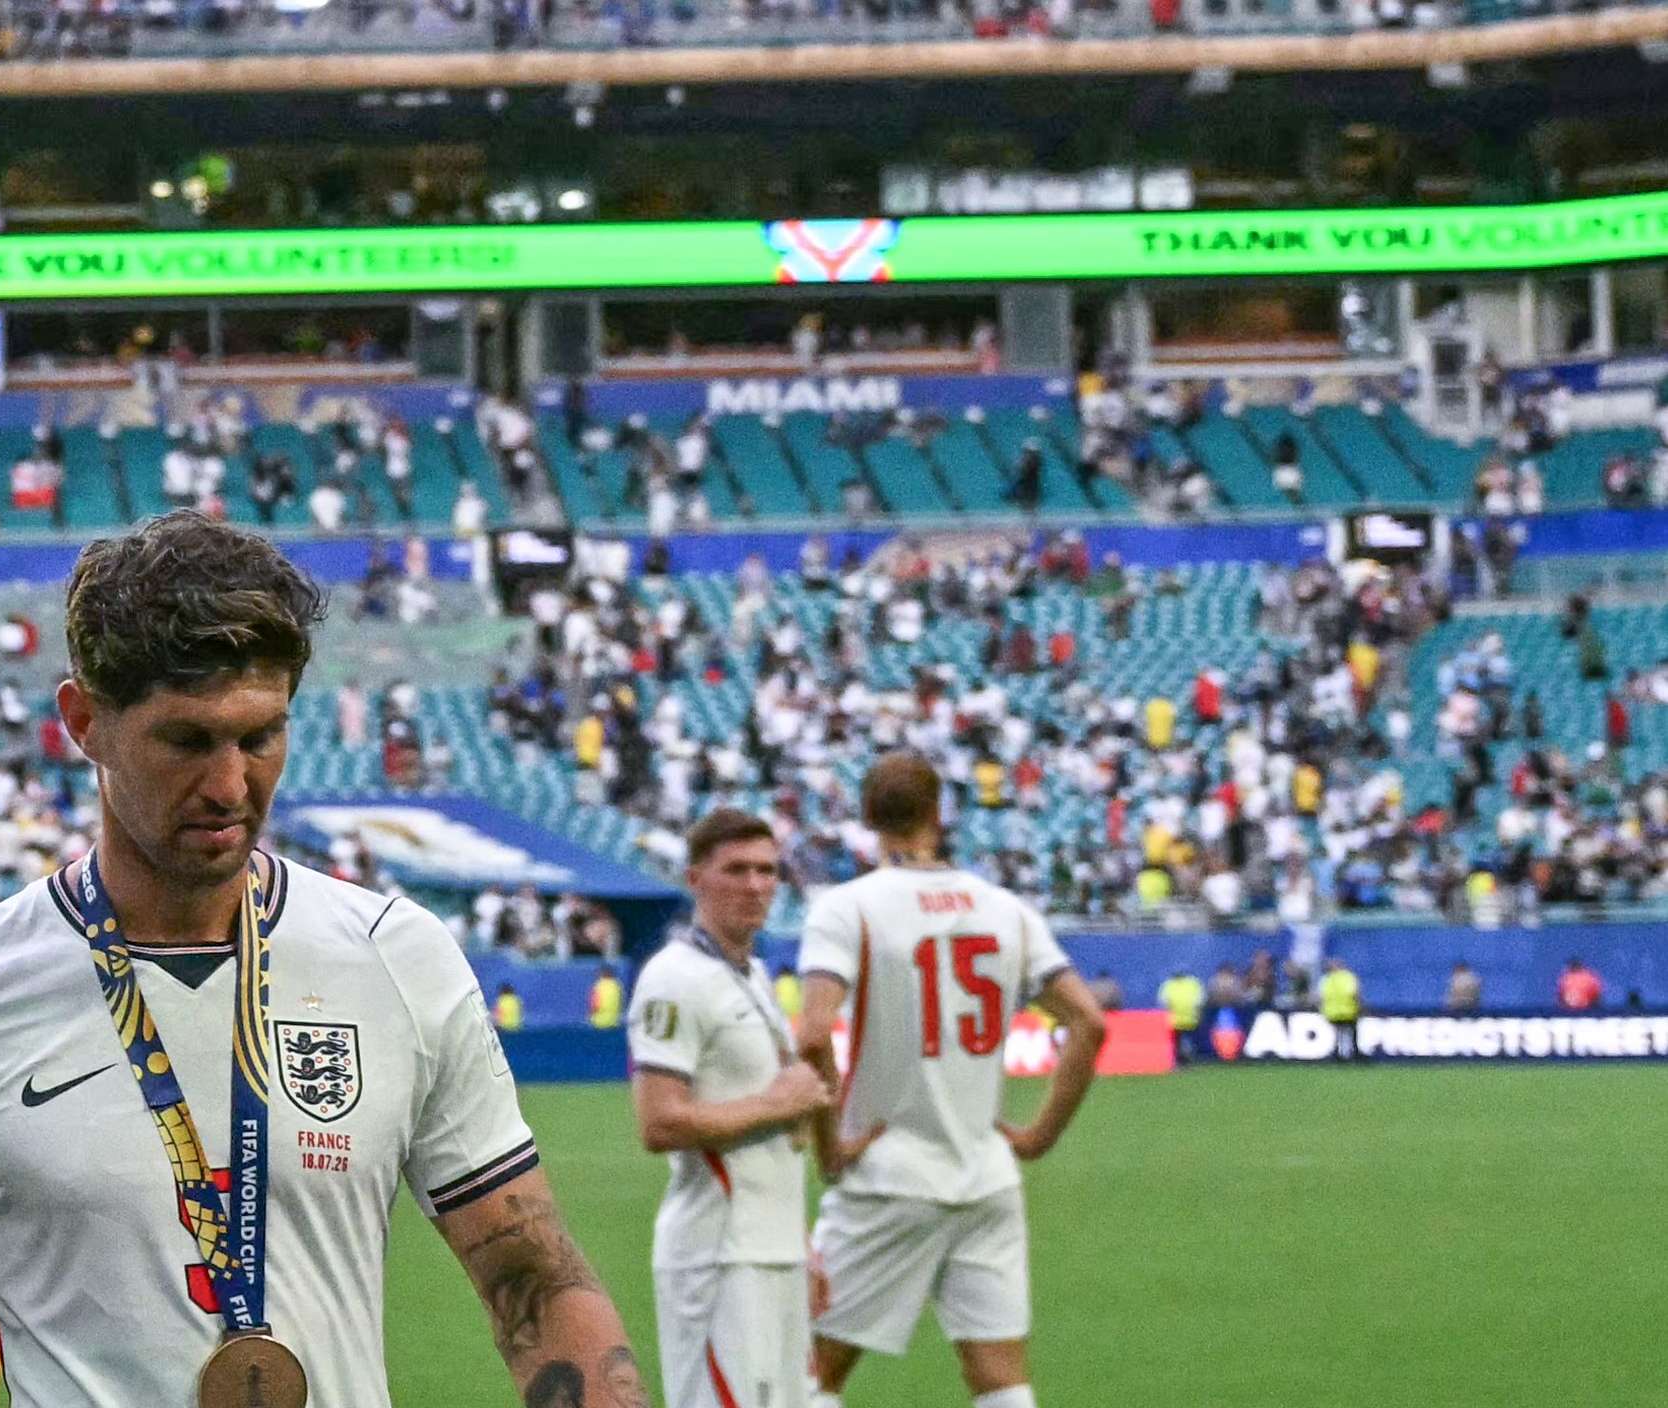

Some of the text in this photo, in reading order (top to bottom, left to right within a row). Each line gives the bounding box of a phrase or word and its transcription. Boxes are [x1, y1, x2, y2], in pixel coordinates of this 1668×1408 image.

[1142, 229, 1308, 252] THANK
[1332, 225, 1432, 249] YOU
[24, 251, 126, 276] YOU
[708, 377, 900, 412] MIAMI
[913, 933, 1004, 1060] 15
[241, 1119, 258, 1164] FIFA
[297, 1130, 352, 1152] FRANCE
[302, 1152, 349, 1172] 18.07.26
[240, 1166, 257, 1241] WORLD
[229, 1294, 254, 1330] FIF
